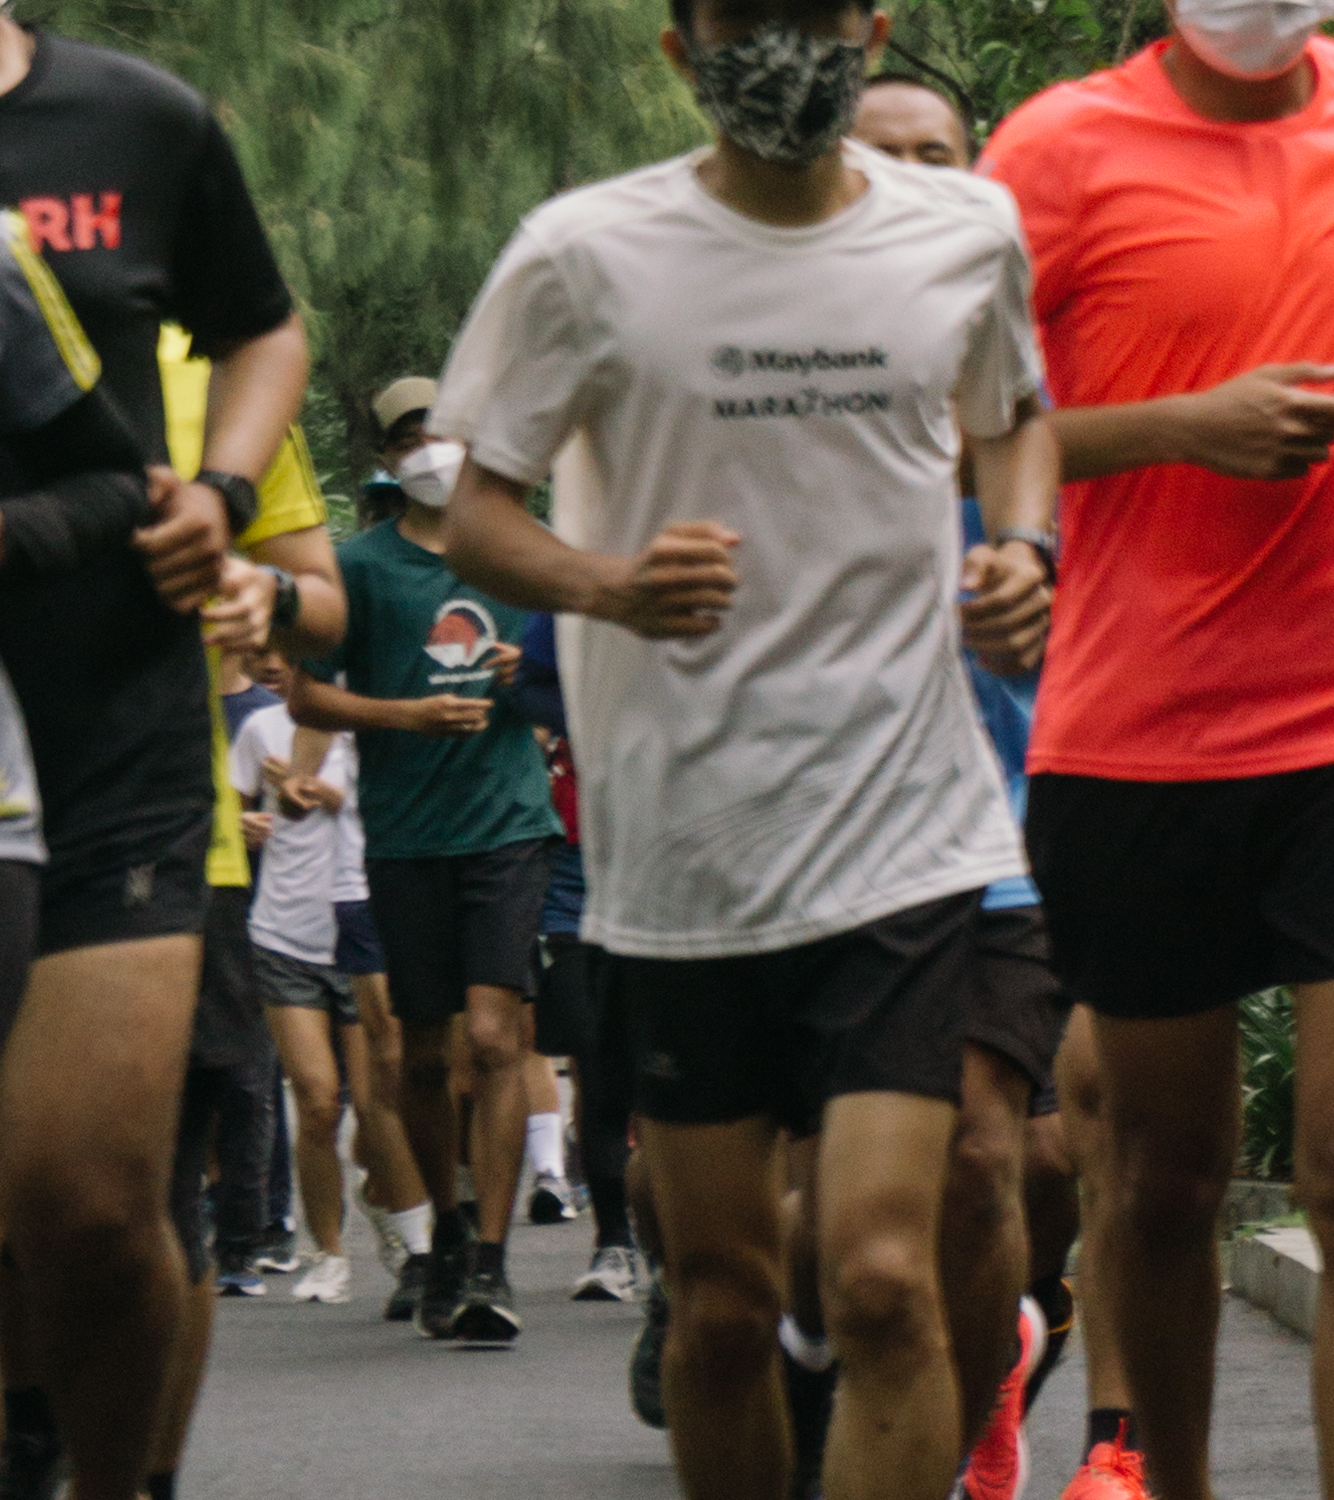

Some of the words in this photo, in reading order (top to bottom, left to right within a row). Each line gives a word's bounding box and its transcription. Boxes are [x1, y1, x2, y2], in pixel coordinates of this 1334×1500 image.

[19, 191, 123, 253] RH
[753, 347, 888, 376] Maybank
[715, 388, 891, 419] MARATHON
